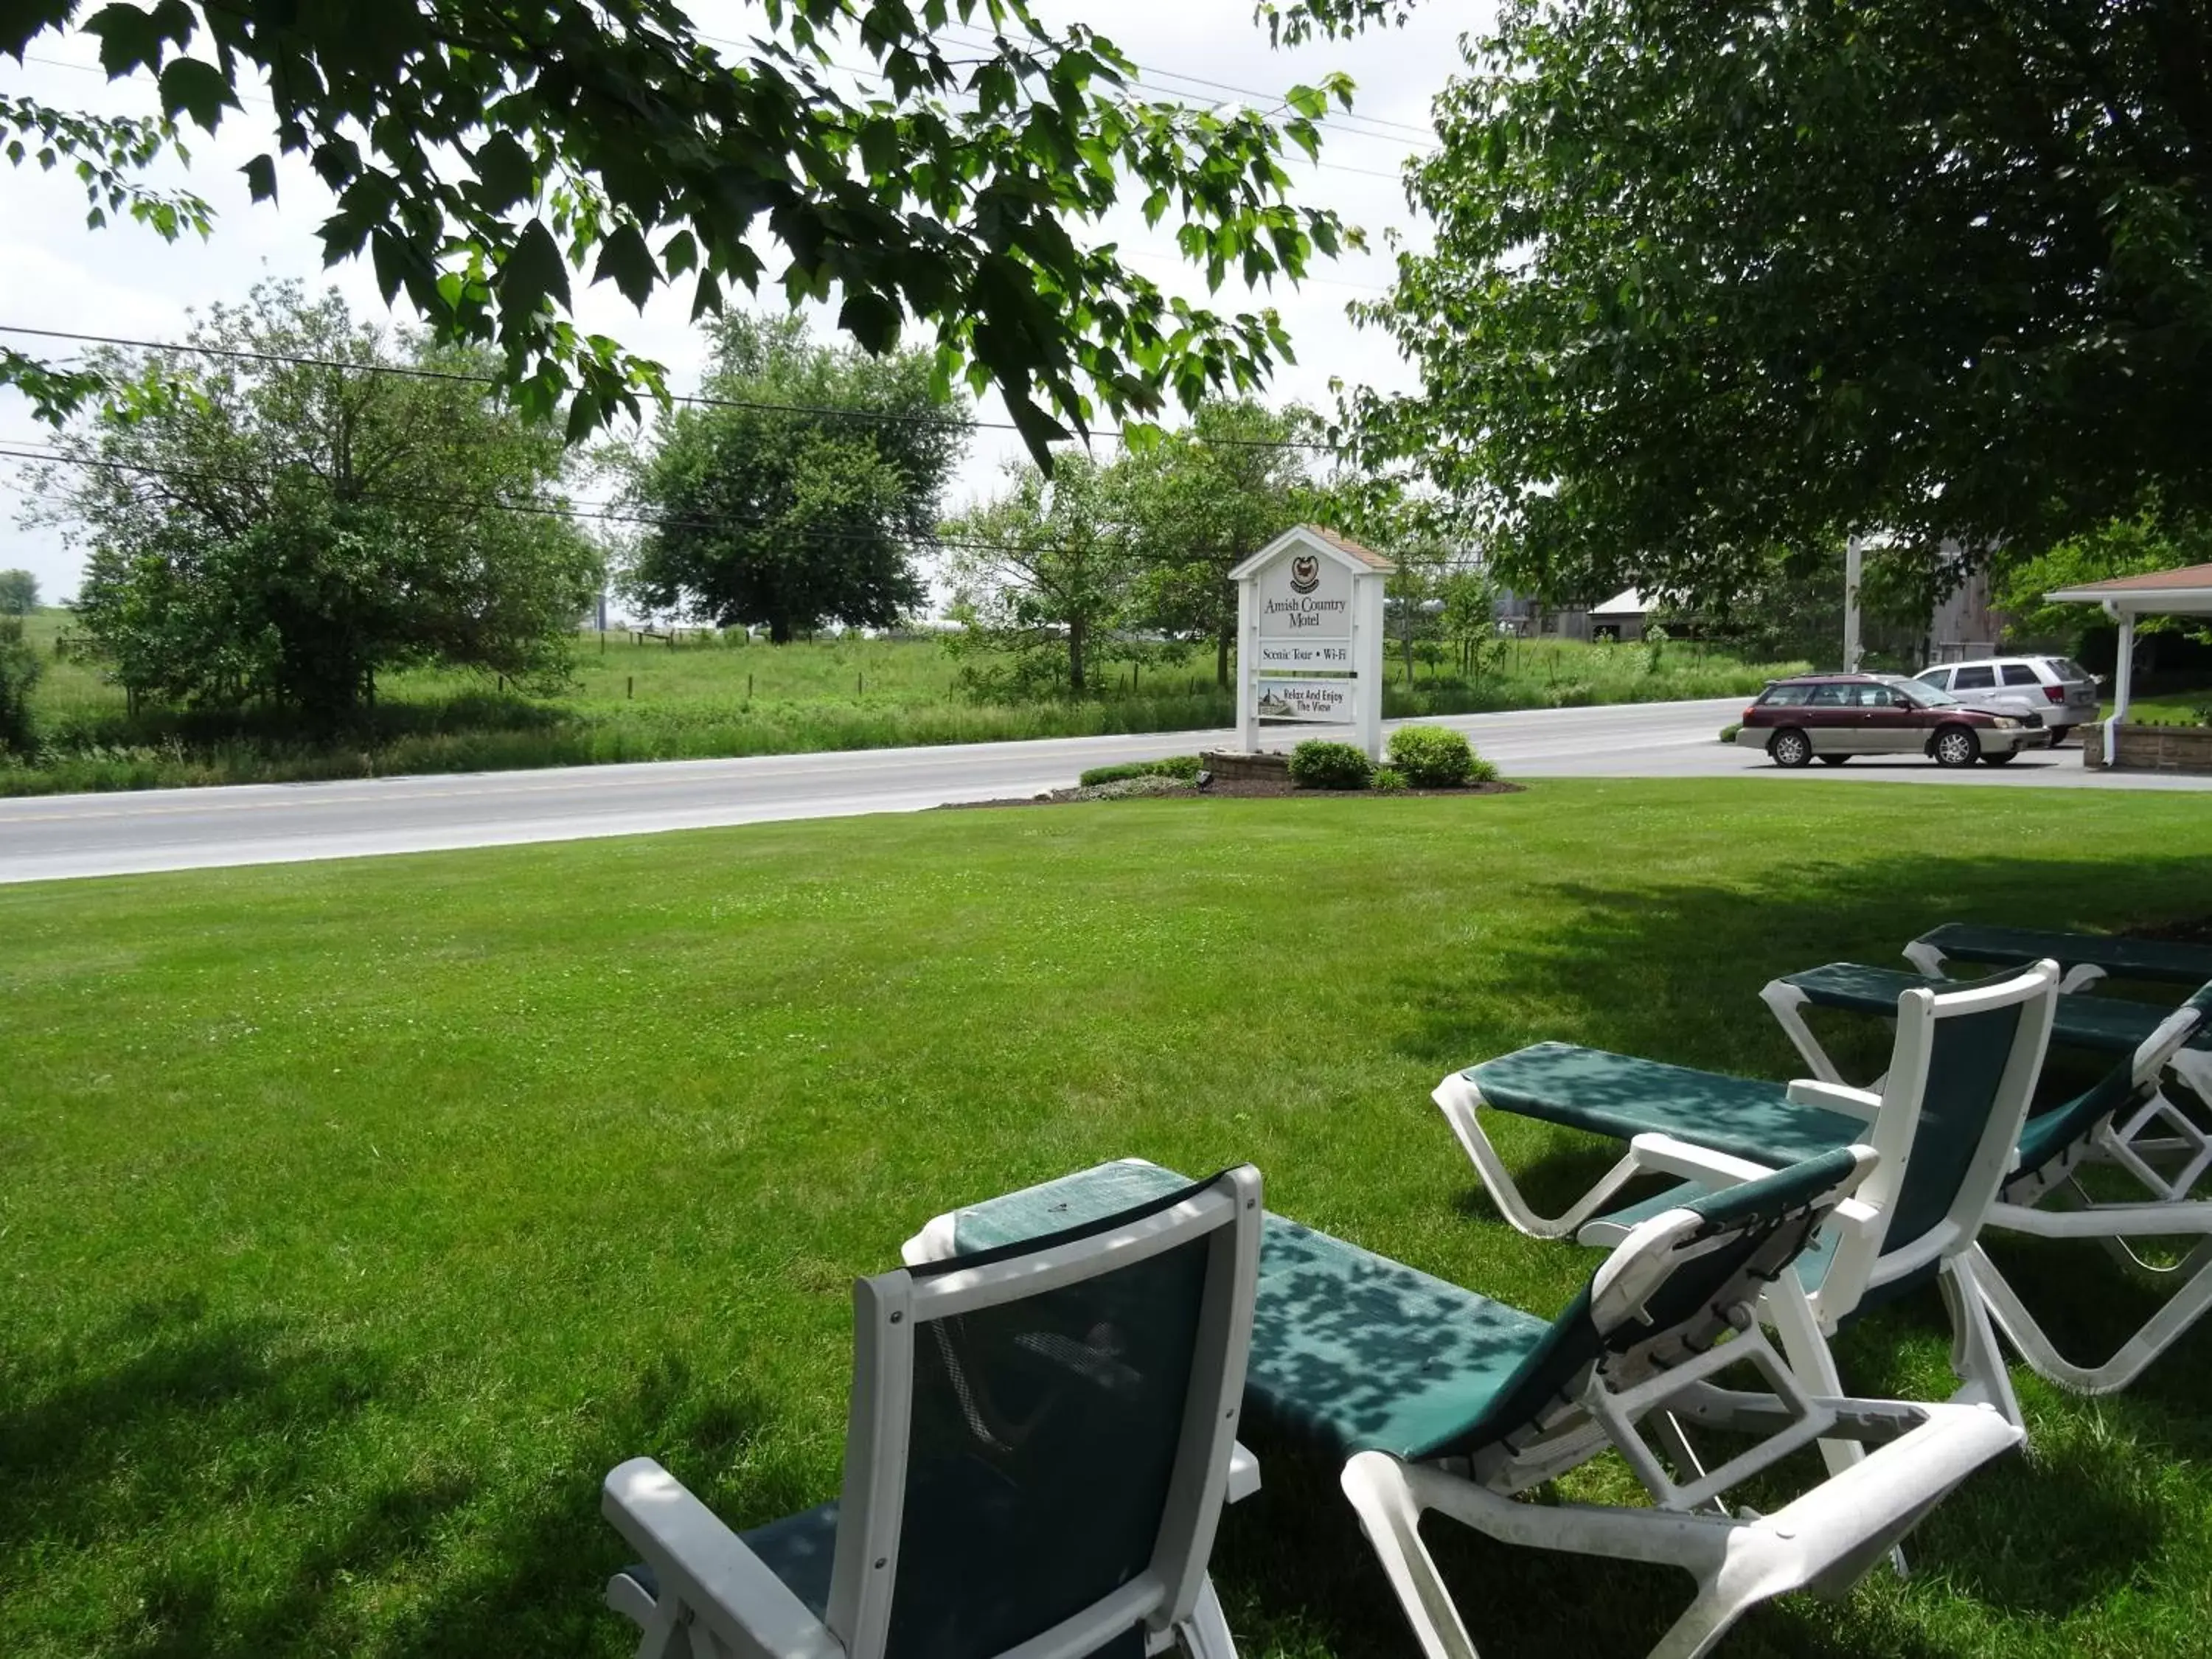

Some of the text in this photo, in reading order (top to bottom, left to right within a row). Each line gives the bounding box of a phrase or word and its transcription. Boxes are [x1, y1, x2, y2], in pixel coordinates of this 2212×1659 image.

[1264, 597, 1346, 614] Amish Country
[1289, 613, 1319, 629] Motel
[1263, 648, 1346, 660] Scenic Tour Wi-Fi
[1284, 688, 1343, 703] Relax And Enjoy
[1298, 700, 1331, 712] The View
